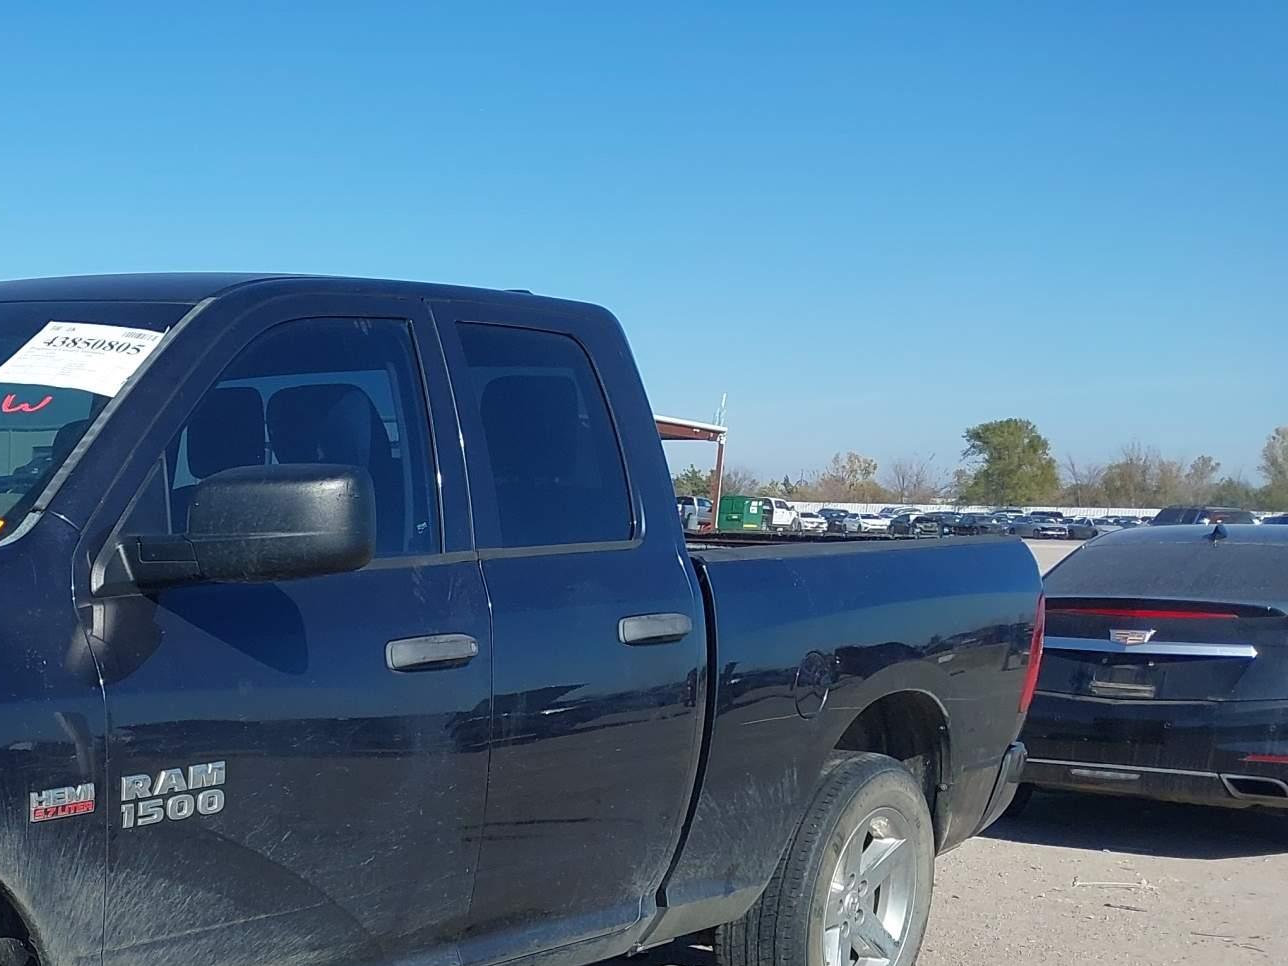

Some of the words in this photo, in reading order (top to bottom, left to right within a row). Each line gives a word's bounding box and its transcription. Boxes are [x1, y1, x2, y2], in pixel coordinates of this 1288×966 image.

[43, 335, 146, 356] 43850805
[120, 760, 227, 801] RAM
[29, 783, 95, 808] HEMI
[57, 800, 94, 817] LITER
[120, 789, 226, 829] 1500
